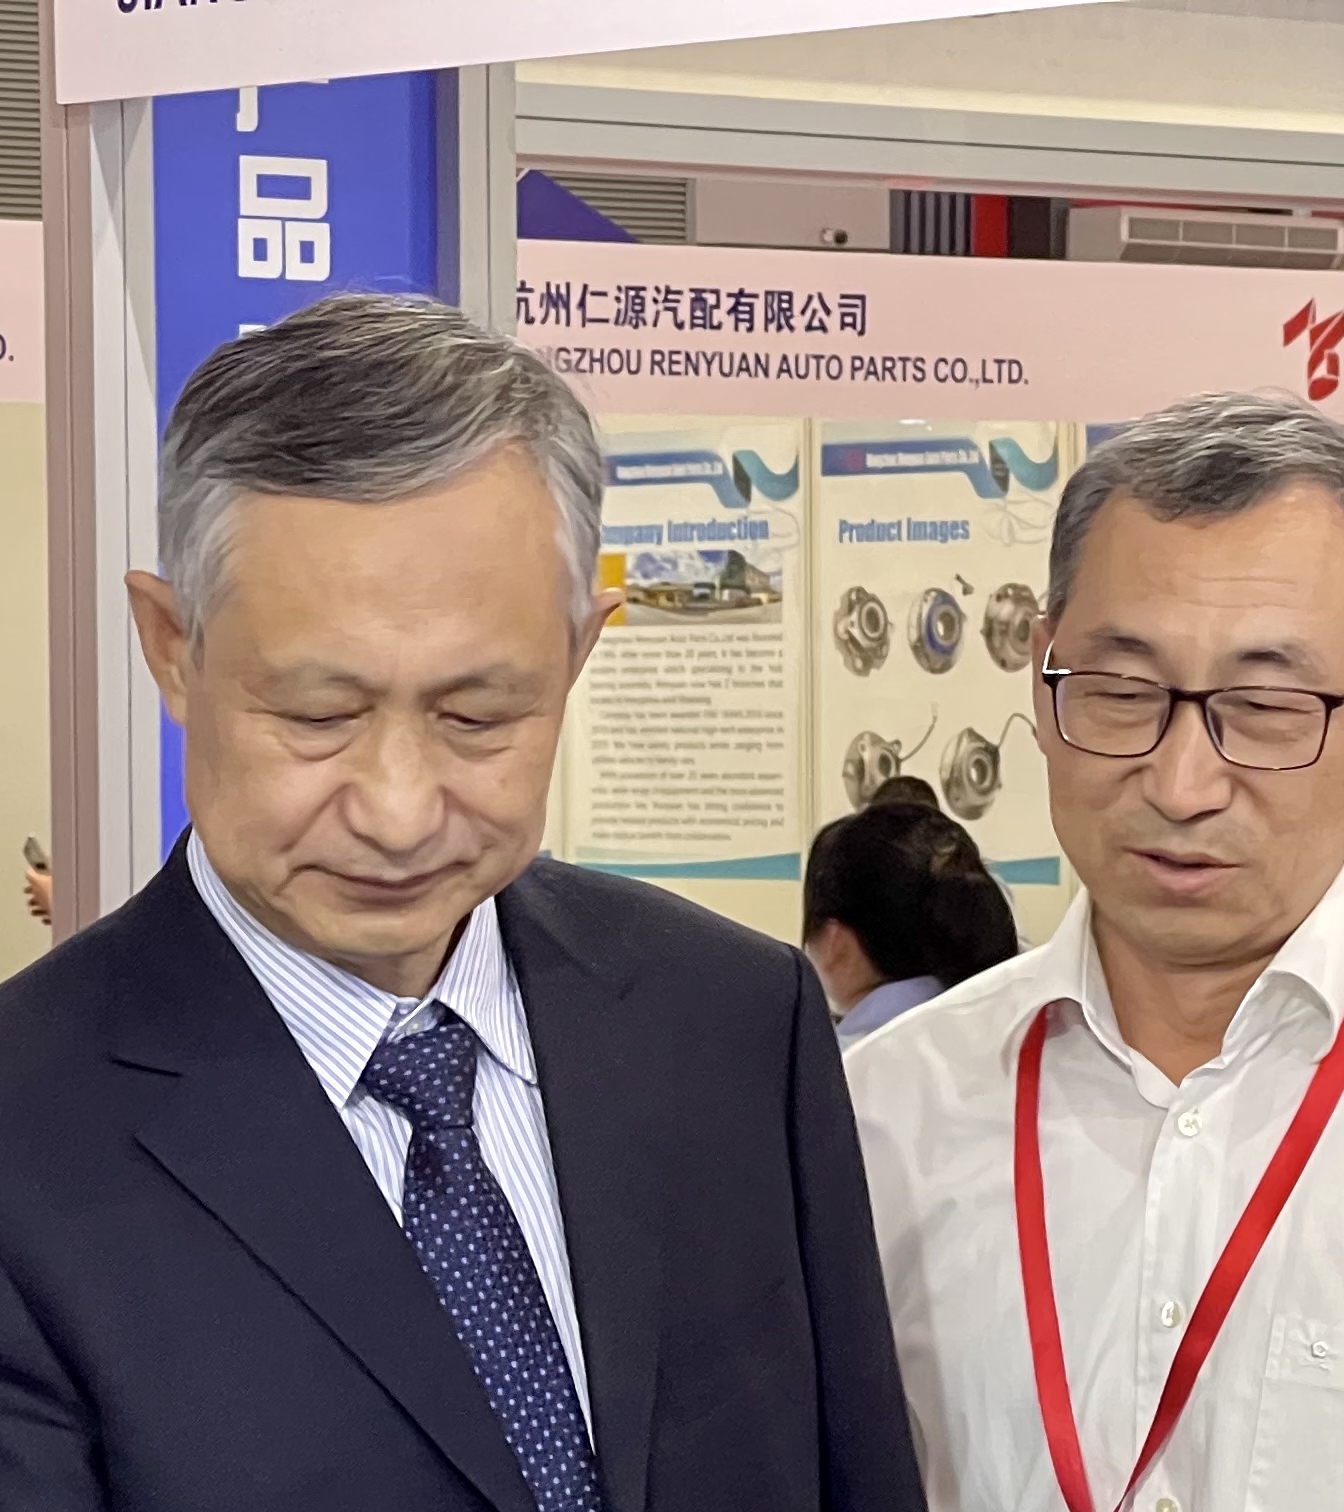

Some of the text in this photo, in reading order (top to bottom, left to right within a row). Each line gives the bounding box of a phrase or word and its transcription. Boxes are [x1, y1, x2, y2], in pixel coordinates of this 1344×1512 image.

[649, 349, 771, 379] RENYUAN
[776, 352, 844, 382] AUTO
[850, 355, 927, 384] PARTS
[839, 517, 970, 544] Product Images
